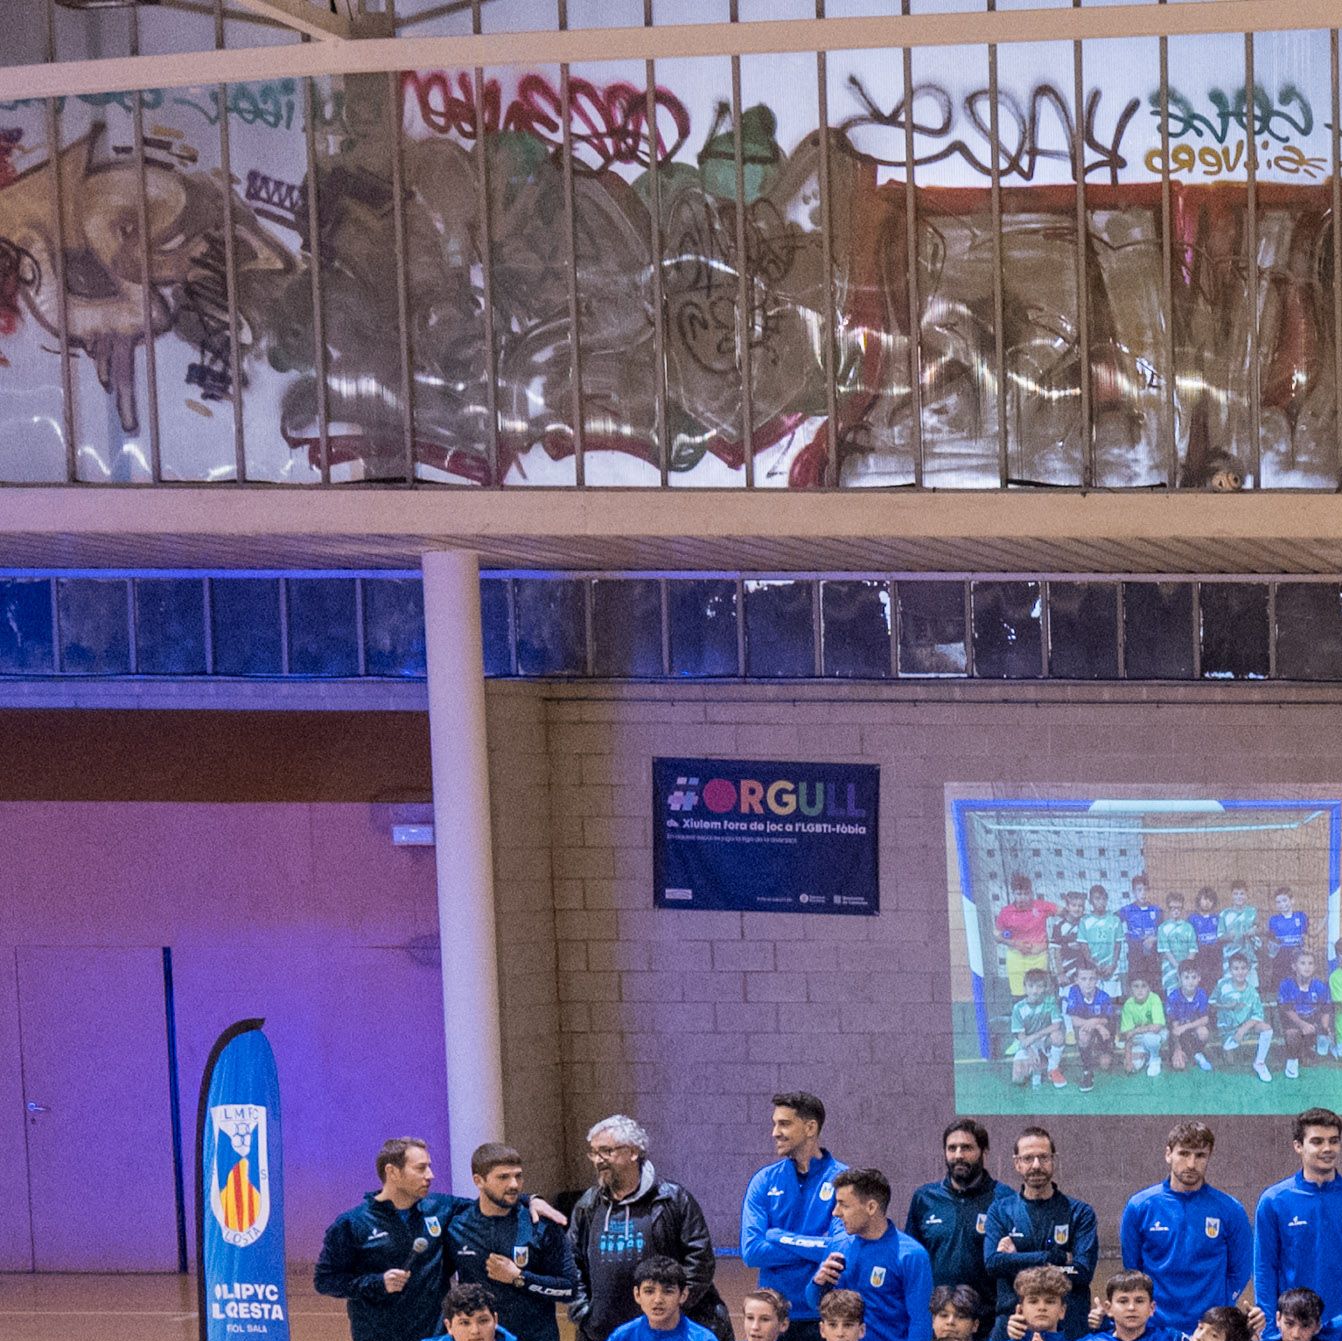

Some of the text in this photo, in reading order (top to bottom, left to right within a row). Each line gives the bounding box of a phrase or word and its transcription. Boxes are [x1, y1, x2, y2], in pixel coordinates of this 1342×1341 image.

[683, 818, 721, 830] Xiulem
[723, 820, 747, 831] fora
[749, 821, 765, 832] de
[766, 821, 783, 833] joc
[784, 824, 794, 832] a
